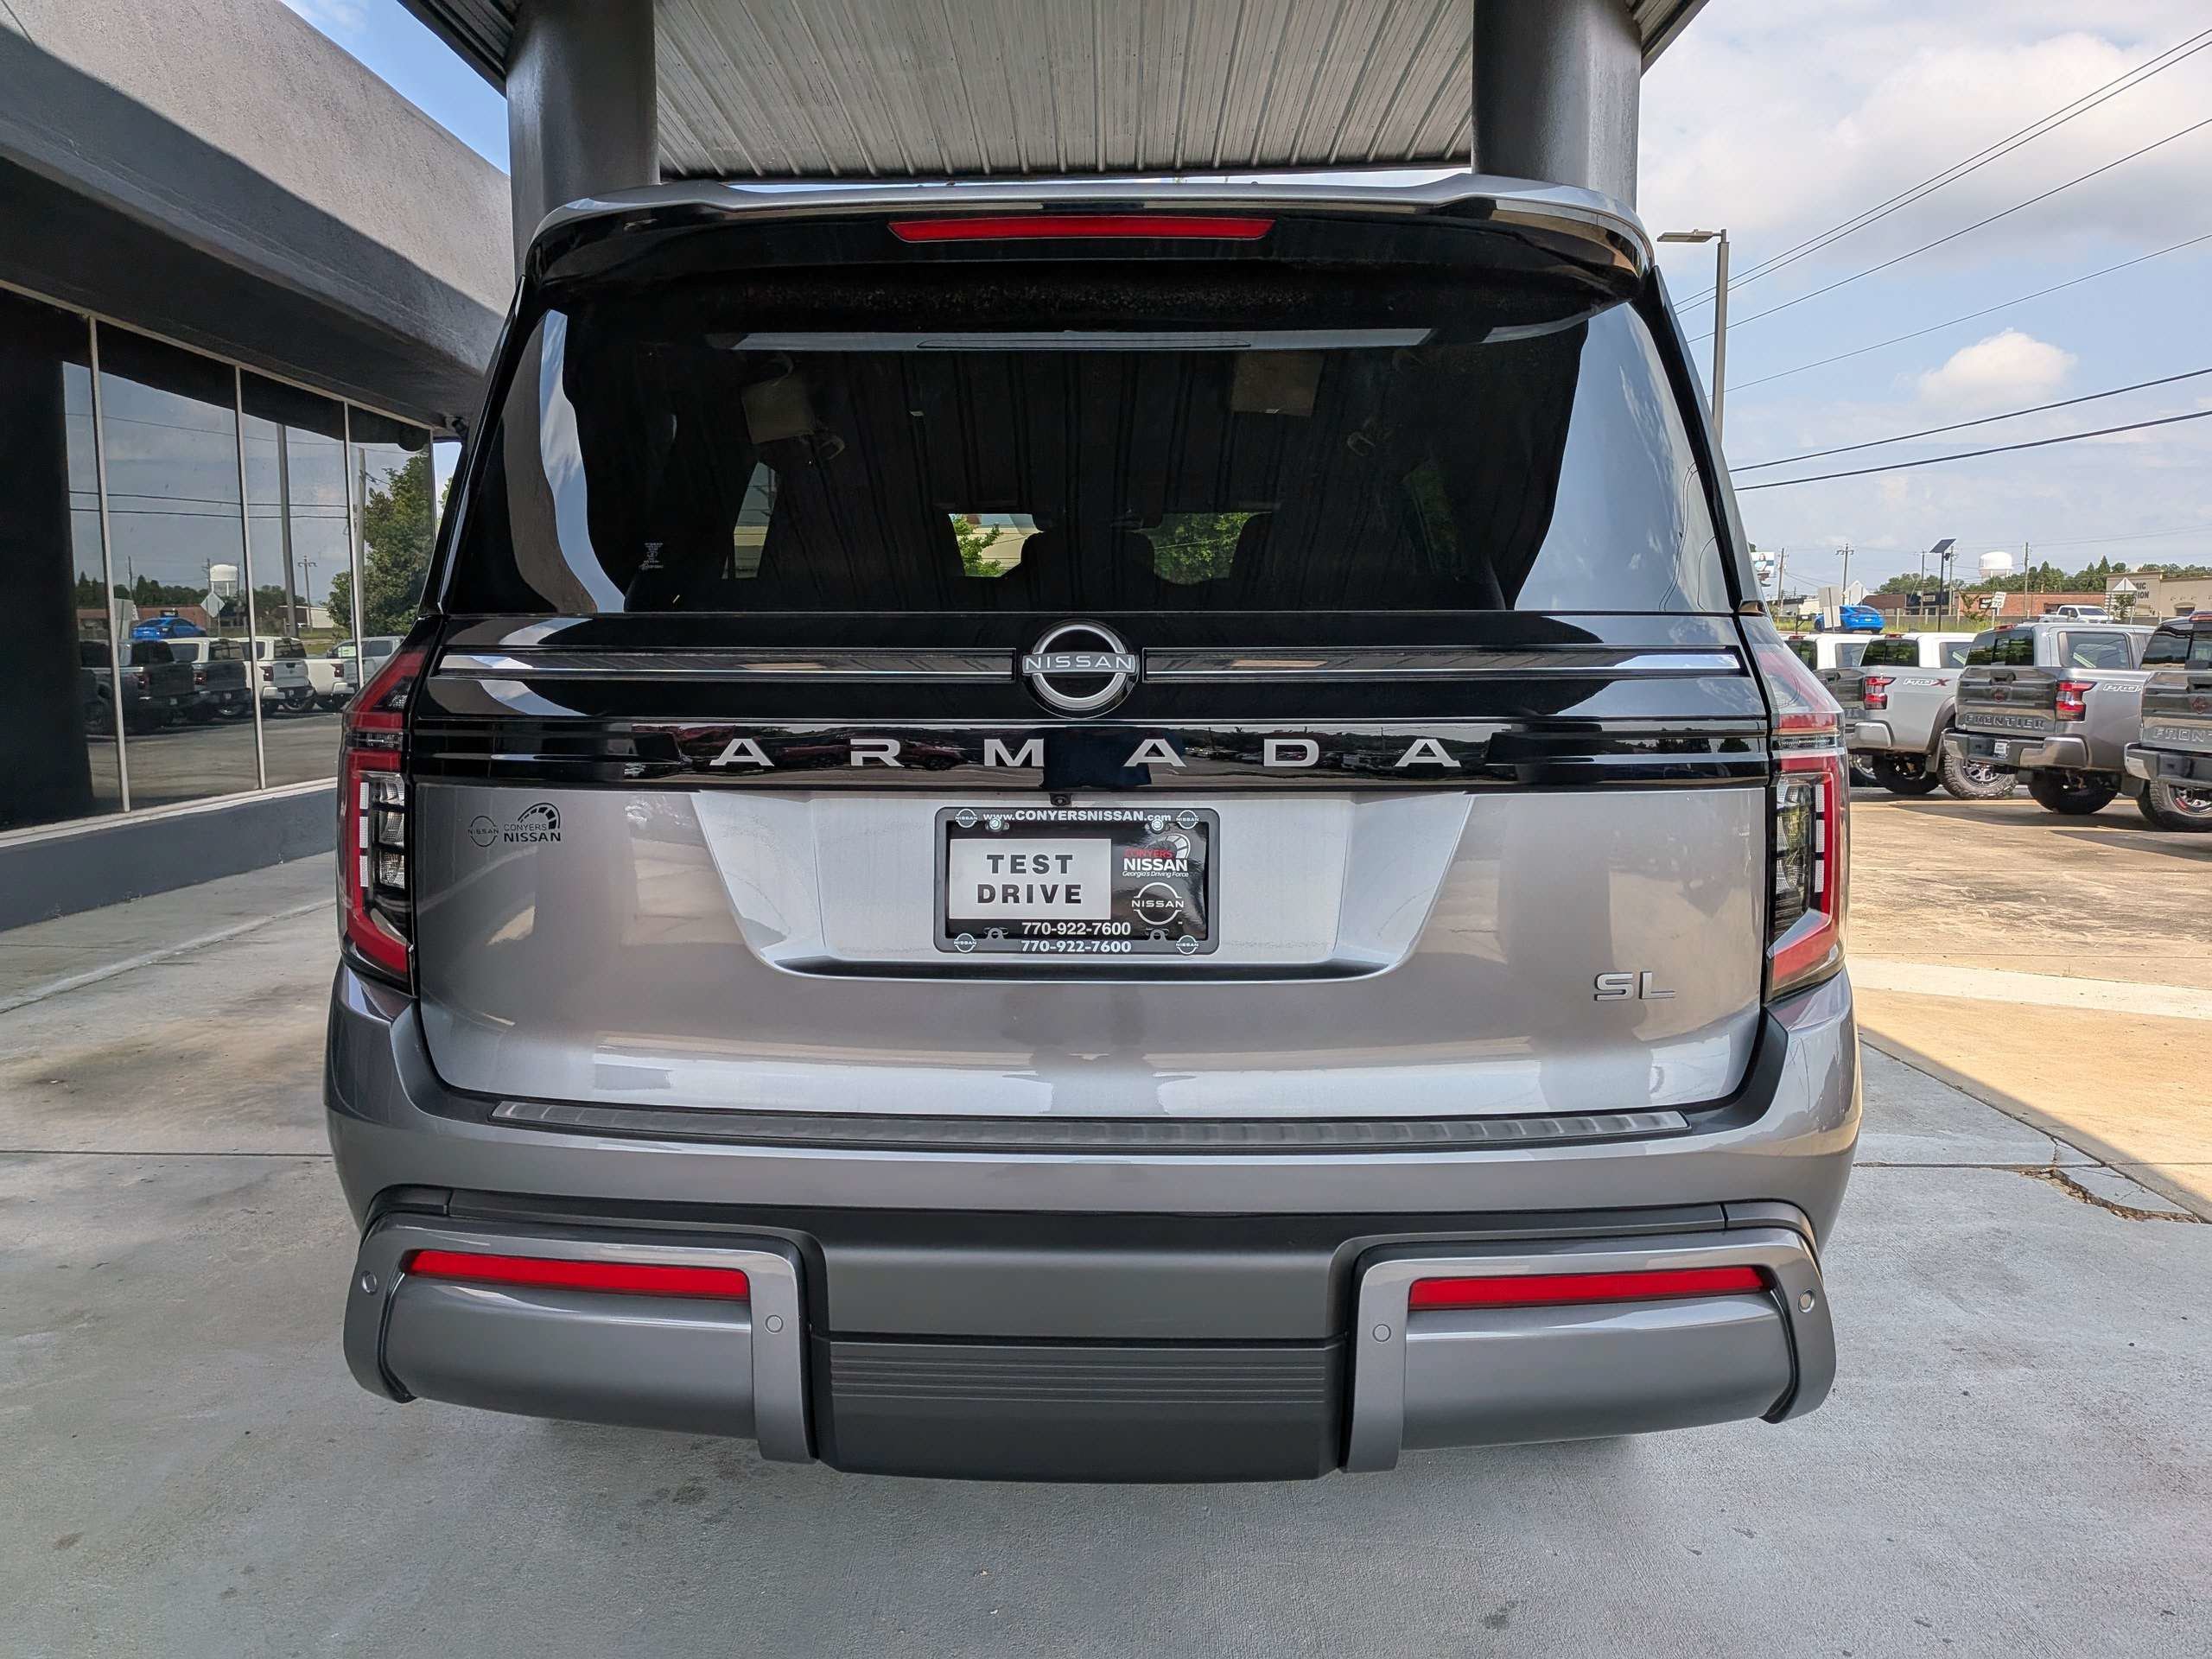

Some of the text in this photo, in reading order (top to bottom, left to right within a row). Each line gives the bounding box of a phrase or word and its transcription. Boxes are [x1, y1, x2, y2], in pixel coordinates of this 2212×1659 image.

[1026, 656, 1132, 671] NISSAN
[1965, 713, 2045, 730] FRONTIER
[709, 737, 1461, 768] ARMADA
[983, 810, 1172, 822] www.CONYERSNISSAN.com
[504, 832, 562, 842] NISSAN
[1124, 848, 1173, 858] CONYERS
[986, 854, 1073, 874] TEST
[1123, 858, 1188, 871] NISSAN
[977, 884, 1083, 904] DRIVE
[1131, 899, 1185, 908] NISSAN
[1021, 922, 1132, 936] 770-922-7600
[1020, 940, 1132, 952] 770-922-7600
[1593, 970, 1676, 1001] SL
